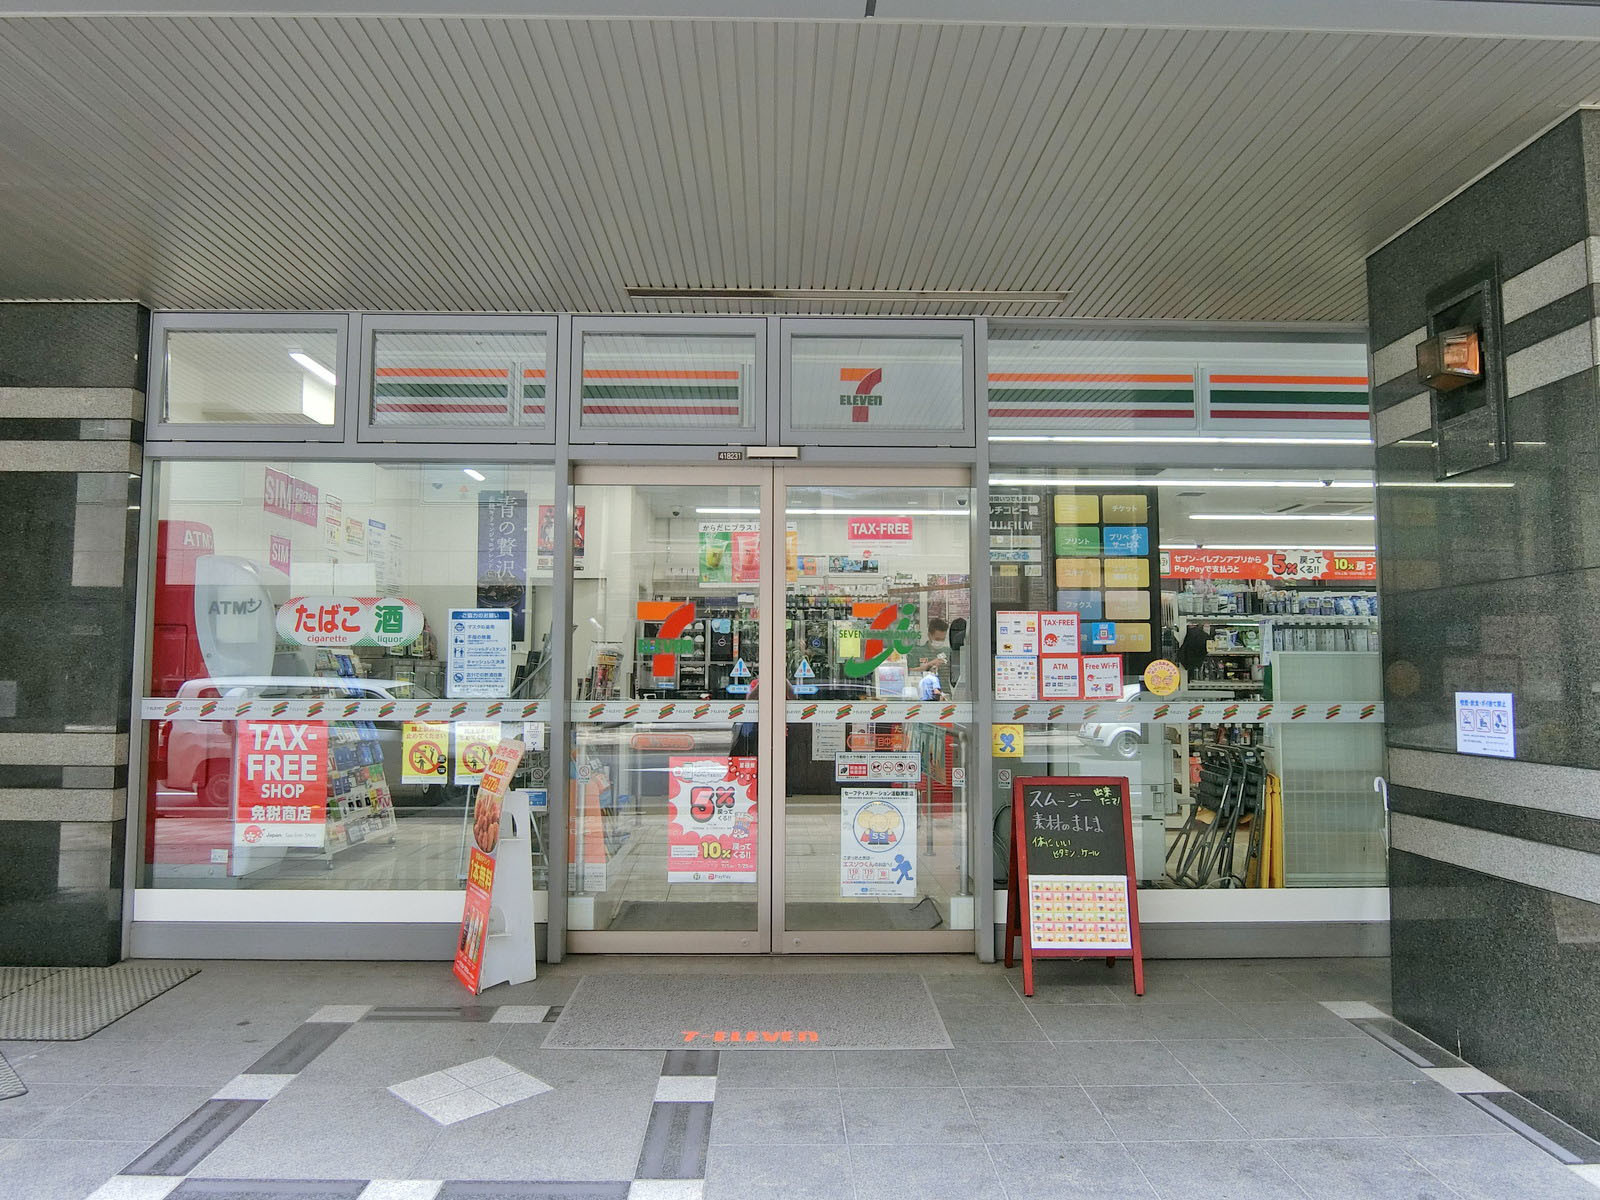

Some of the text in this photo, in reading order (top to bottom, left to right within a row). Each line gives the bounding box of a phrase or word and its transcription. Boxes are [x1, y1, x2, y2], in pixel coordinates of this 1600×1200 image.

[840, 395, 882, 405] ELEVEN
[719, 452, 741, 460] 418231
[851, 523, 909, 535] TAX-FREE
[1271, 553, 1298, 576] 5%
[1300, 556, 1321, 564] 戻って
[1356, 561, 1376, 570] 戻っ
[1174, 565, 1239, 574] PayPayで支払うと
[295, 603, 360, 633] たばこ
[375, 605, 403, 633] 酒
[307, 635, 347, 643] cigarette
[377, 635, 403, 643] liquor
[839, 629, 865, 639] SEVEN
[248, 724, 317, 751] TAX-
[247, 754, 317, 780] FREE
[261, 783, 304, 799] SHOP
[1029, 790, 1092, 808] スムージー
[691, 786, 735, 823] 5%
[251, 805, 312, 821] 免税商店
[1032, 811, 1104, 833] 素材のまんま
[701, 841, 731, 859] 10%
[680, 1031, 819, 1042] 7-ELEVEN
